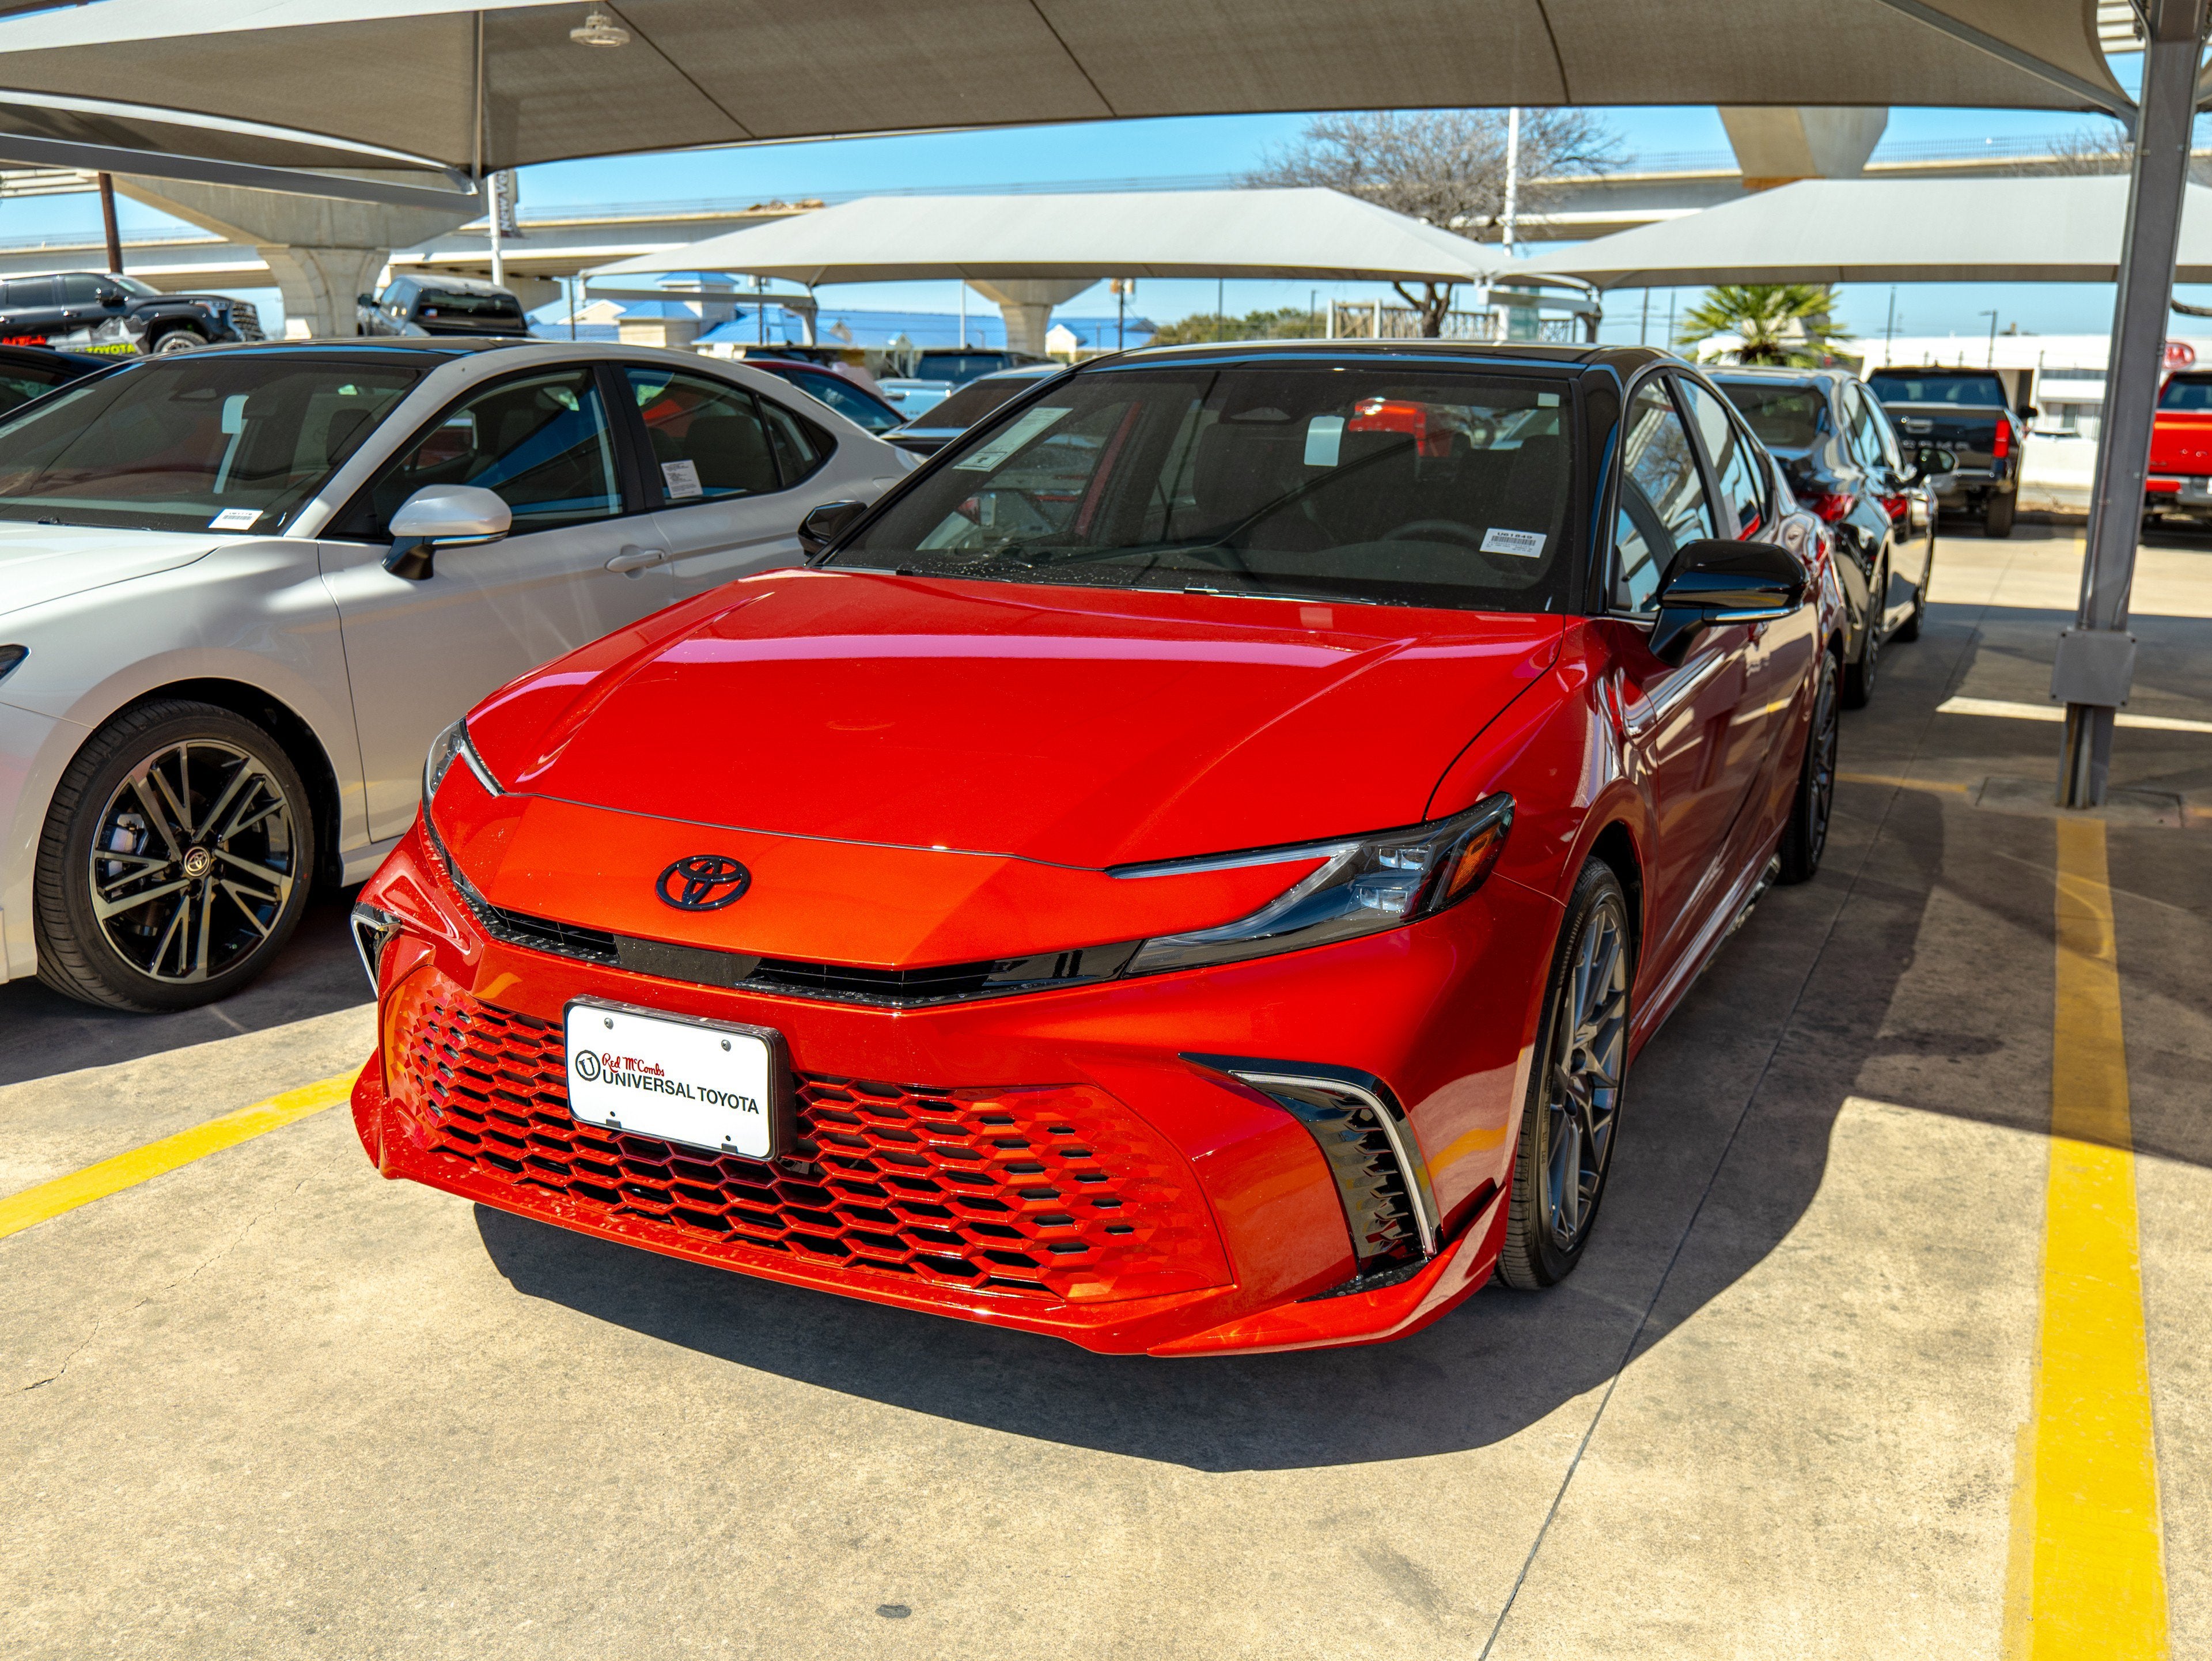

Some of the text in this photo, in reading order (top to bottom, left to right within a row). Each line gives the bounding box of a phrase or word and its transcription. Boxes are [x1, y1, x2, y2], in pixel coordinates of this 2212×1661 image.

[499, 198, 512, 232] New
[602, 1053, 665, 1076] Red McCombs
[603, 1070, 759, 1114] UNIVERSAL TOYOTA
